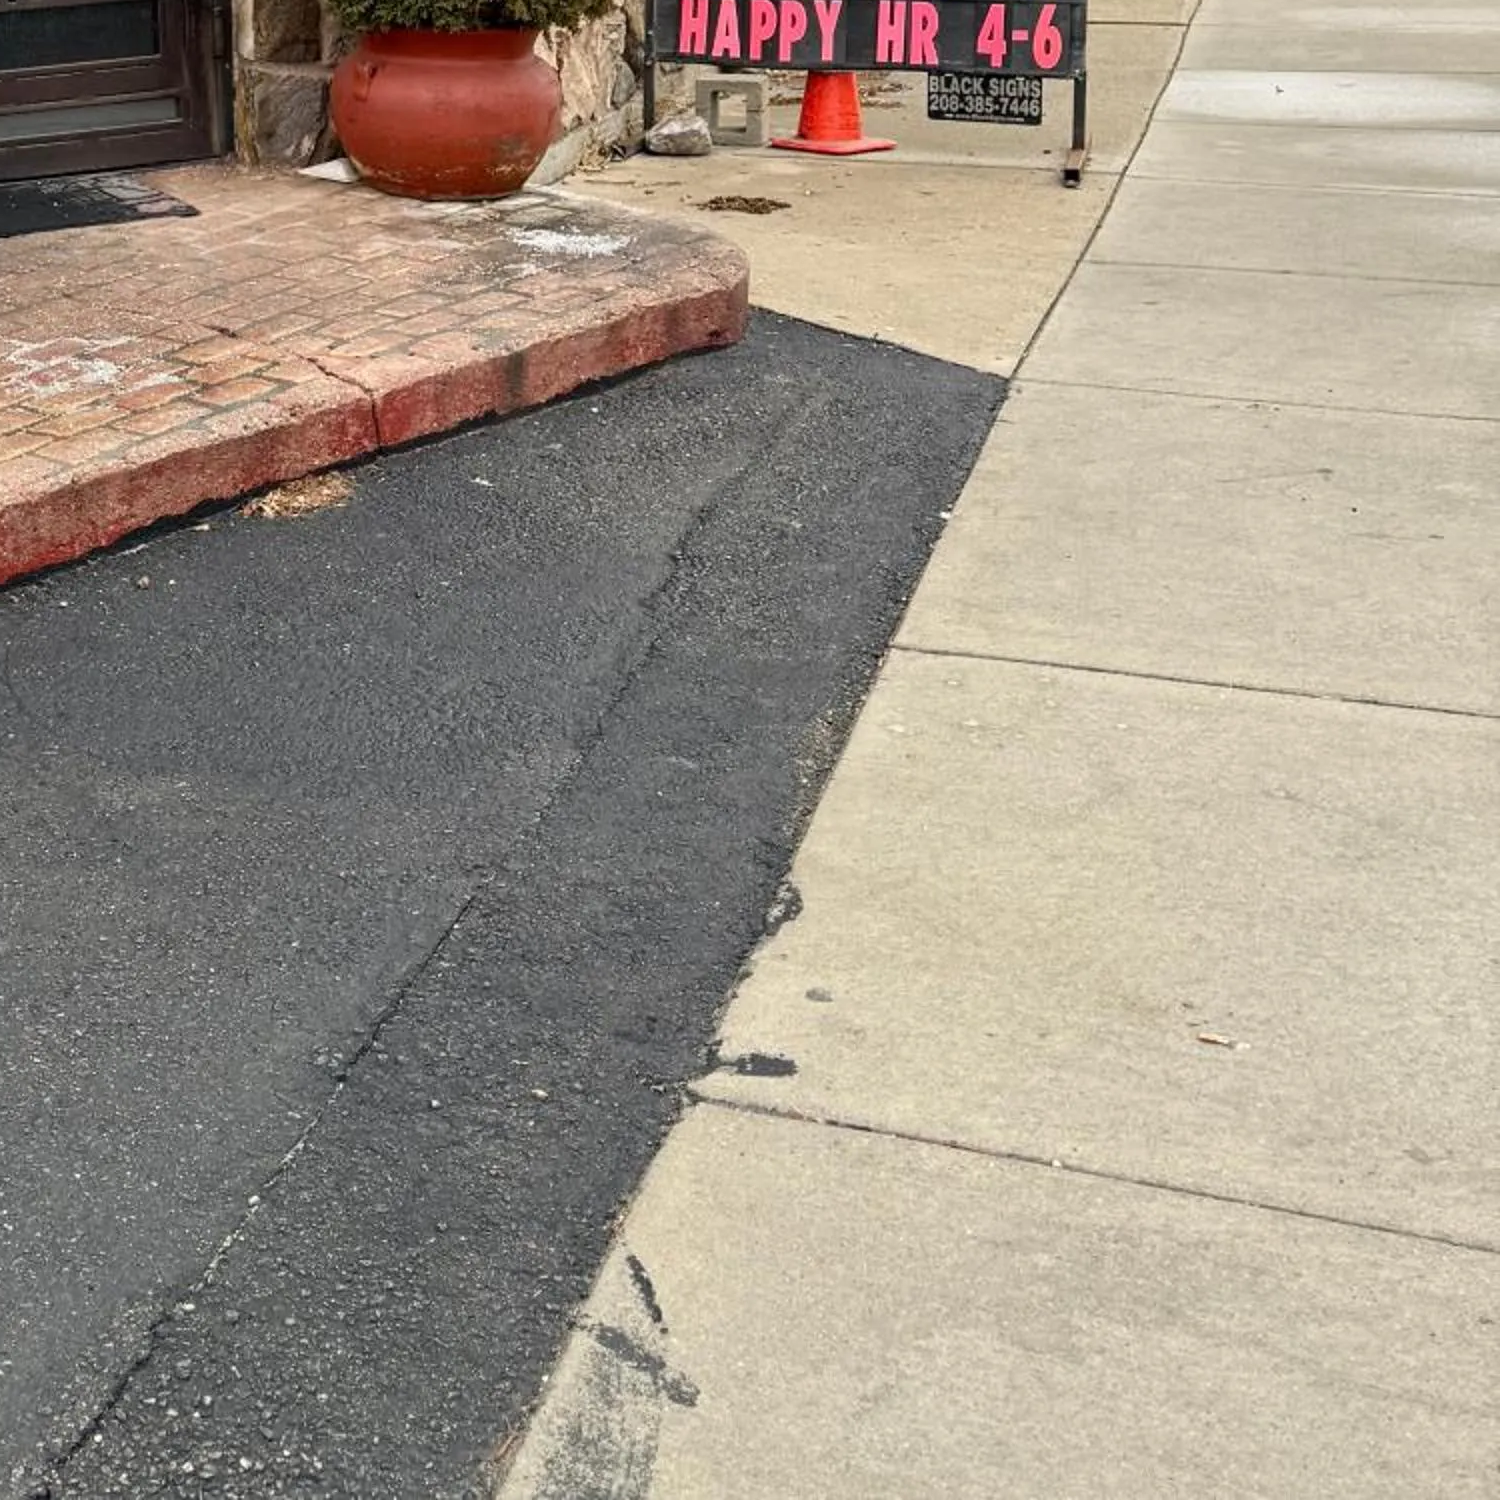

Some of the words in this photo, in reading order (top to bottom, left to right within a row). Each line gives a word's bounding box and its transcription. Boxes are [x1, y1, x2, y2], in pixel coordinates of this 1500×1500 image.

[877, 1, 939, 66] HR
[976, 3, 1063, 69] 4-6
[929, 75, 986, 95] BLACK
[989, 76, 1041, 99] SIGNS
